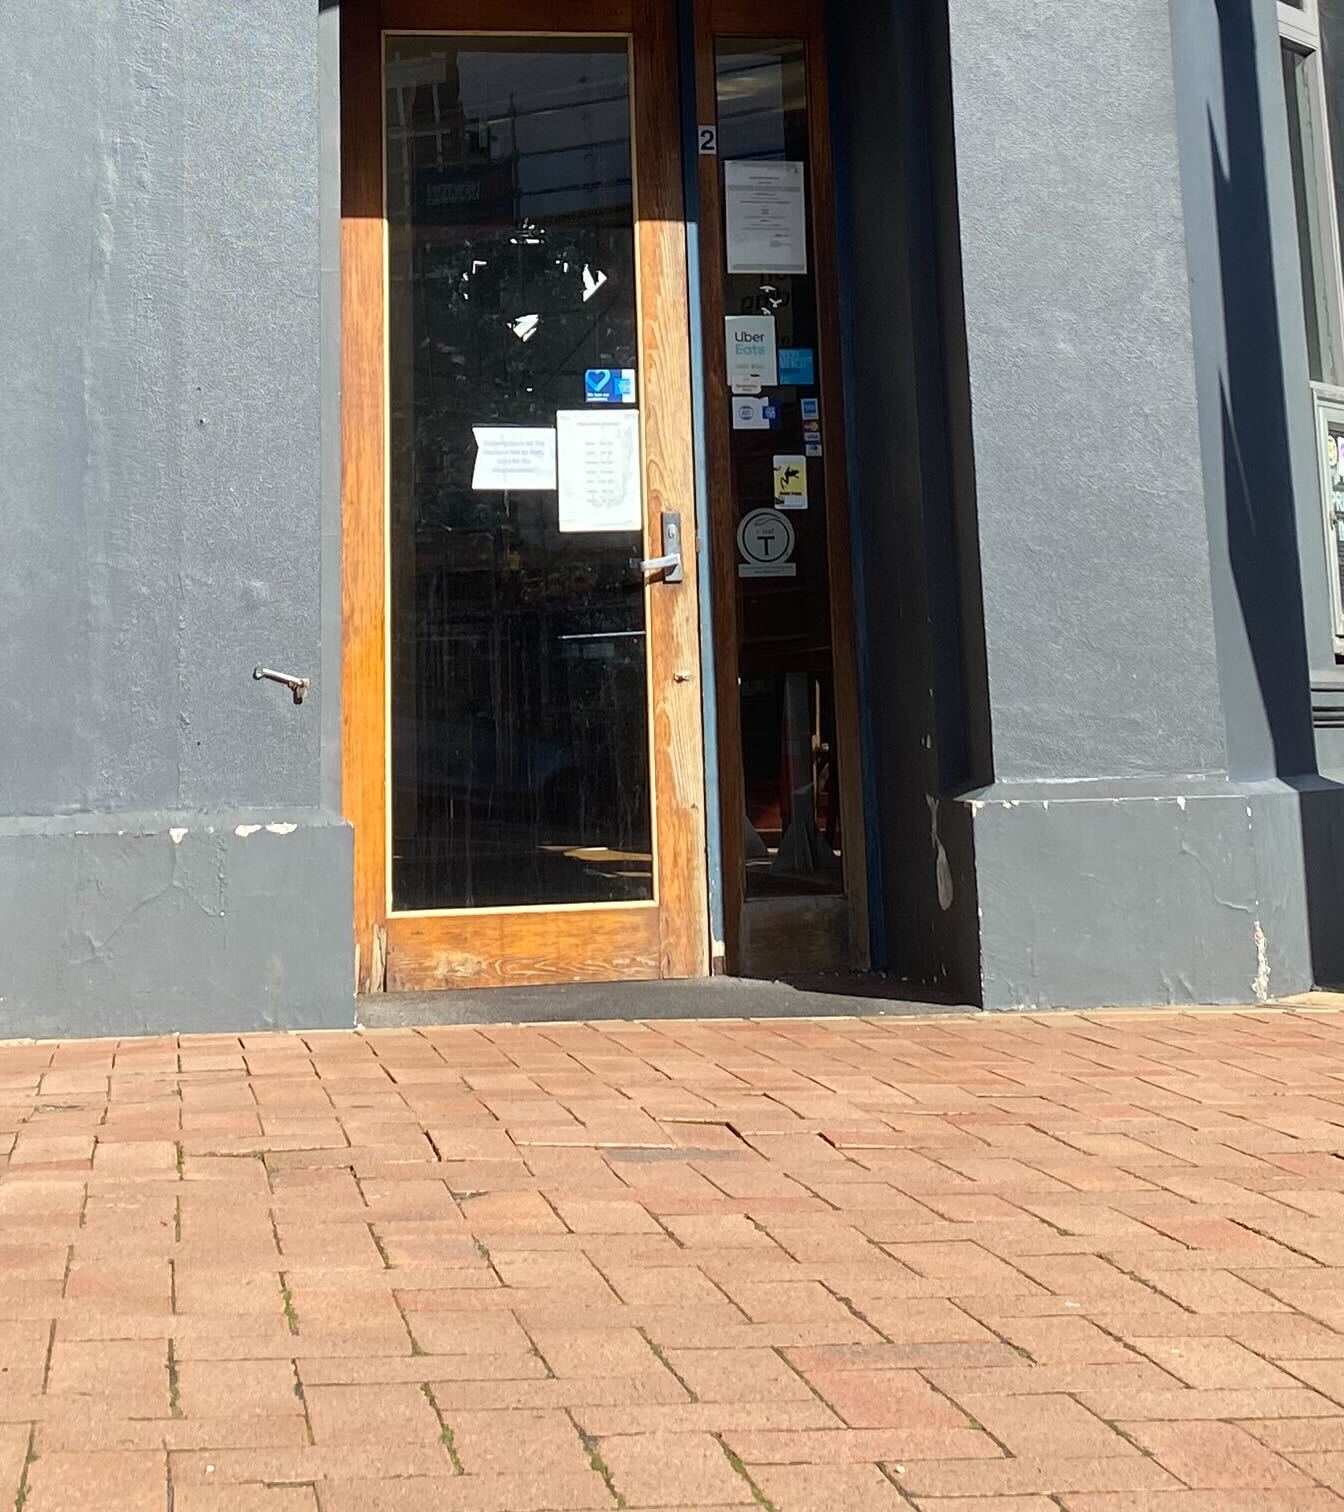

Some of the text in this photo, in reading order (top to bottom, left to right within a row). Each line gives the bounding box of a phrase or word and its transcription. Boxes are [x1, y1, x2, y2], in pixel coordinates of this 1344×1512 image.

[700, 129, 715, 151] 2
[735, 331, 765, 343] Uber
[735, 344, 766, 355] Eats
[757, 536, 775, 556] T
